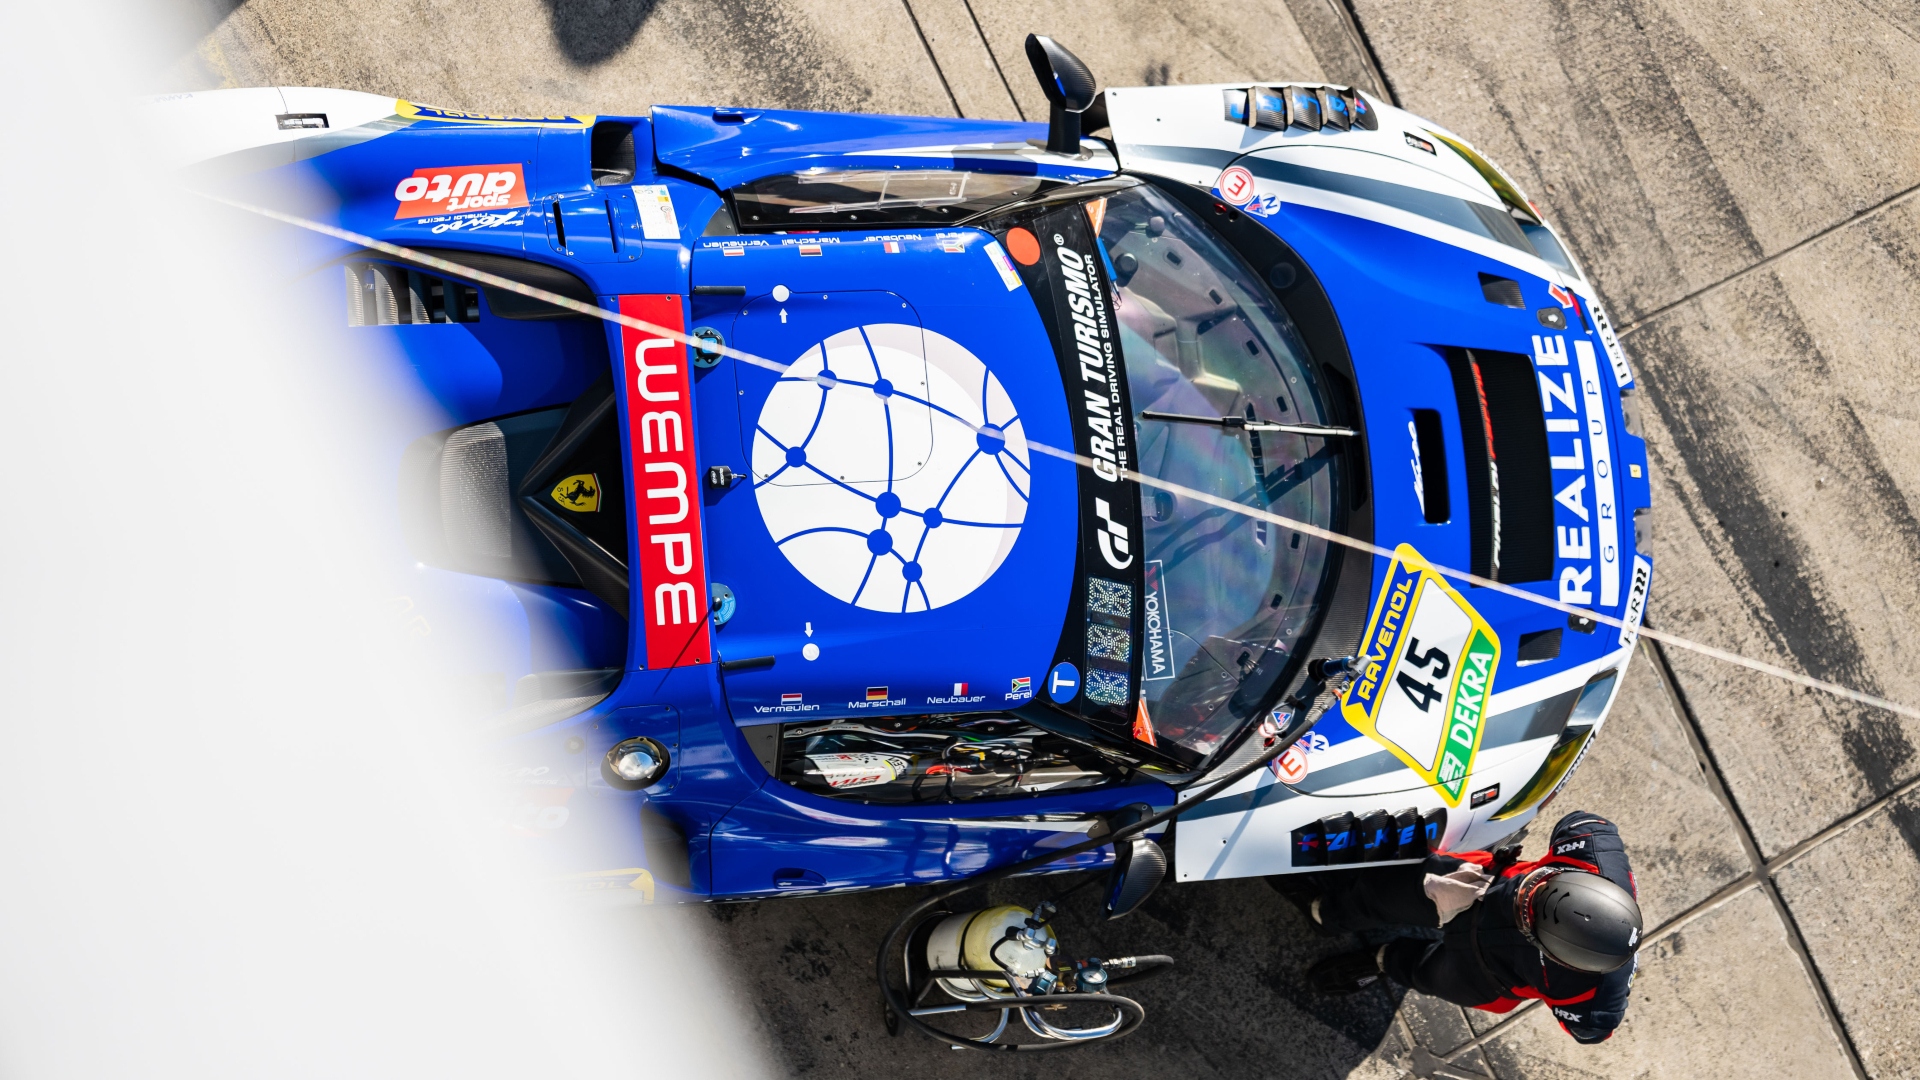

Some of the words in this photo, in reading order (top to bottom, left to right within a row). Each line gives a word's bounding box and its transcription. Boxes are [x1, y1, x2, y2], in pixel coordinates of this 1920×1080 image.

[395, 171, 517, 203] auto
[1226, 174, 1246, 196] E
[446, 192, 511, 212] sport
[703, 239, 770, 248] Vermeulen
[782, 236, 841, 246] Marschall
[863, 233, 922, 243] Neubauer
[1084, 254, 1110, 339] SIMULATOR
[1104, 342, 1121, 403] DRIVING
[1084, 389, 1118, 483] GRAN
[1114, 407, 1125, 447] REAL
[635, 338, 697, 626] WEMPE
[1118, 450, 1129, 482] THE
[1532, 335, 1592, 604] REALIZE
[1586, 379, 1615, 563] GROUP
[1144, 591, 1166, 675] YOKOHAMA
[1357, 579, 1413, 700] RAVENOL
[1052, 671, 1076, 694] T
[1396, 636, 1451, 713] 45
[754, 703, 820, 713] Vermeulen
[848, 698, 907, 709] Marschall
[926, 694, 986, 705] Neubauer
[1005, 689, 1033, 701] Perel
[1450, 652, 1494, 749] DEKRA
[1278, 751, 1303, 777] E
[1554, 1007, 1583, 1024] HRX
